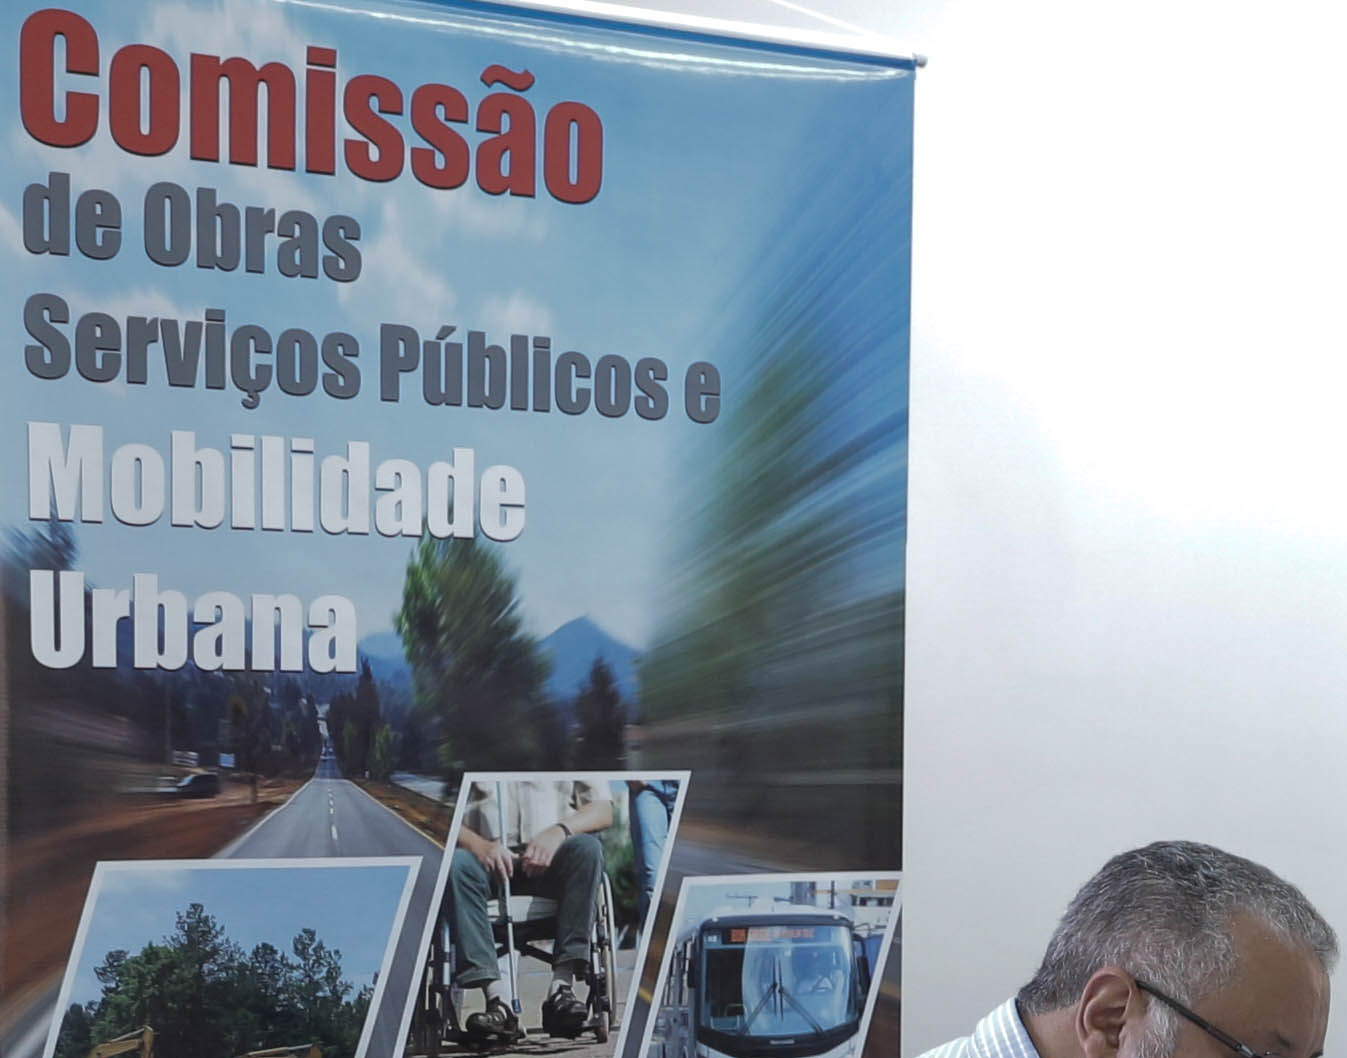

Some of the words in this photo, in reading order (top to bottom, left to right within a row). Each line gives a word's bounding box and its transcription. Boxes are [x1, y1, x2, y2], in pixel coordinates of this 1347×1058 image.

[19, 8, 604, 204] Comissão
[21, 171, 122, 261] de
[143, 181, 362, 283] Obras
[23, 293, 361, 410] Serviços
[379, 323, 669, 422] Públicos
[684, 357, 722, 424] e
[27, 421, 528, 543] Mobilidade
[28, 569, 358, 675] Urbana
